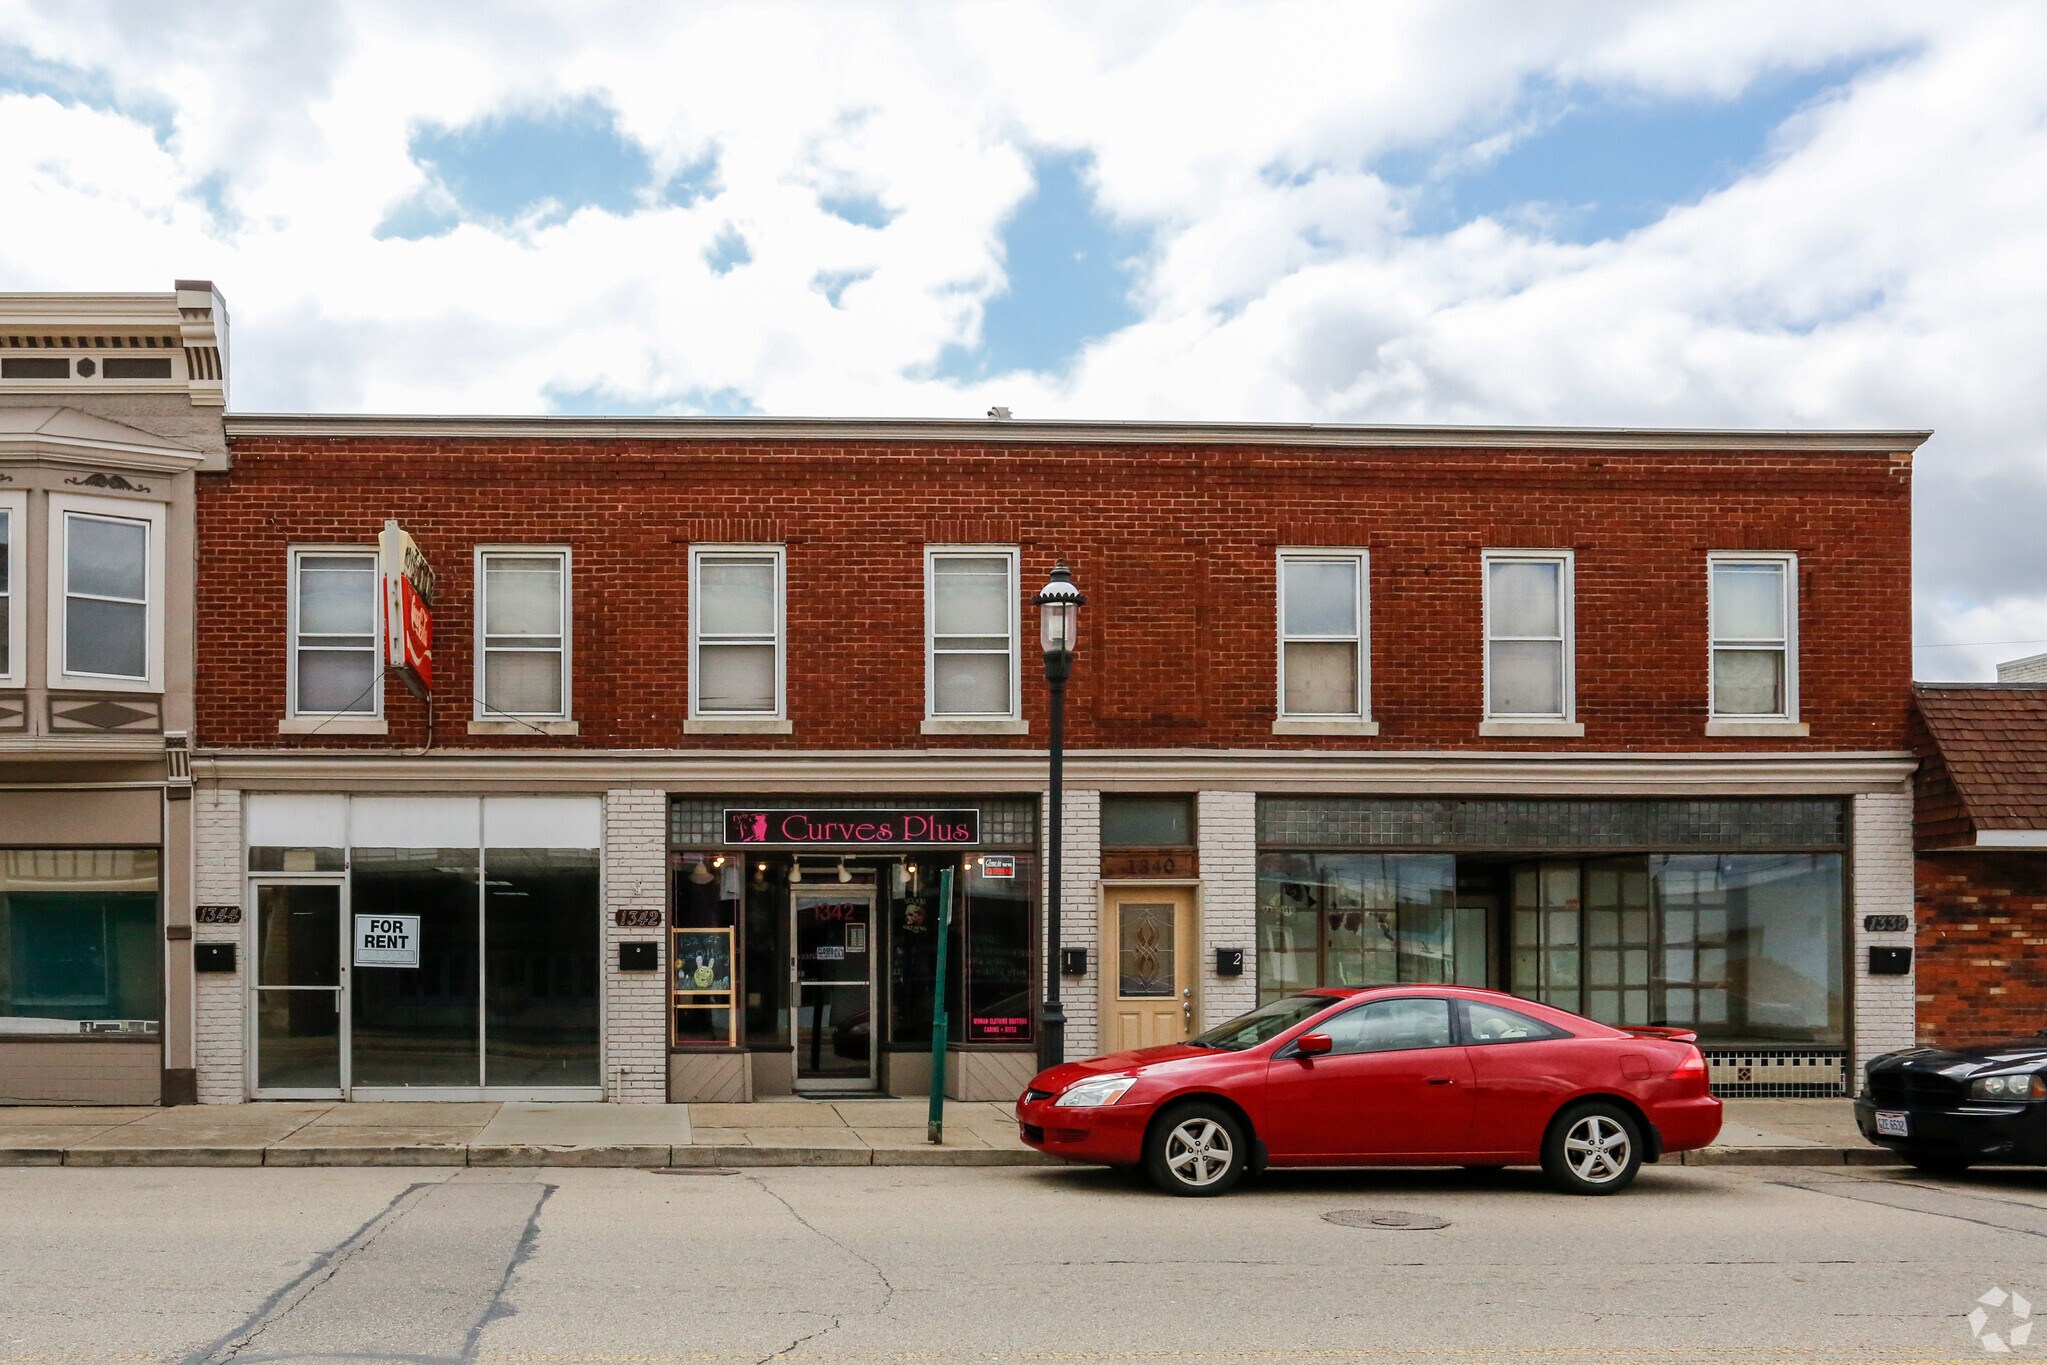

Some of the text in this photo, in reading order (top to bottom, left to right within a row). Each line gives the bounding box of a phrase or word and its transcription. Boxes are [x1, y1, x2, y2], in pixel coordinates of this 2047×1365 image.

[781, 814, 970, 842] Curves Plus
[985, 867, 1012, 875] OPEN
[199, 907, 239, 922] 1344
[620, 910, 659, 926] 1342
[813, 902, 855, 922] 1342
[370, 920, 404, 933] FOR
[1869, 916, 1907, 931] 1338
[364, 934, 409, 949] RENT
[1232, 952, 1242, 965] 2
